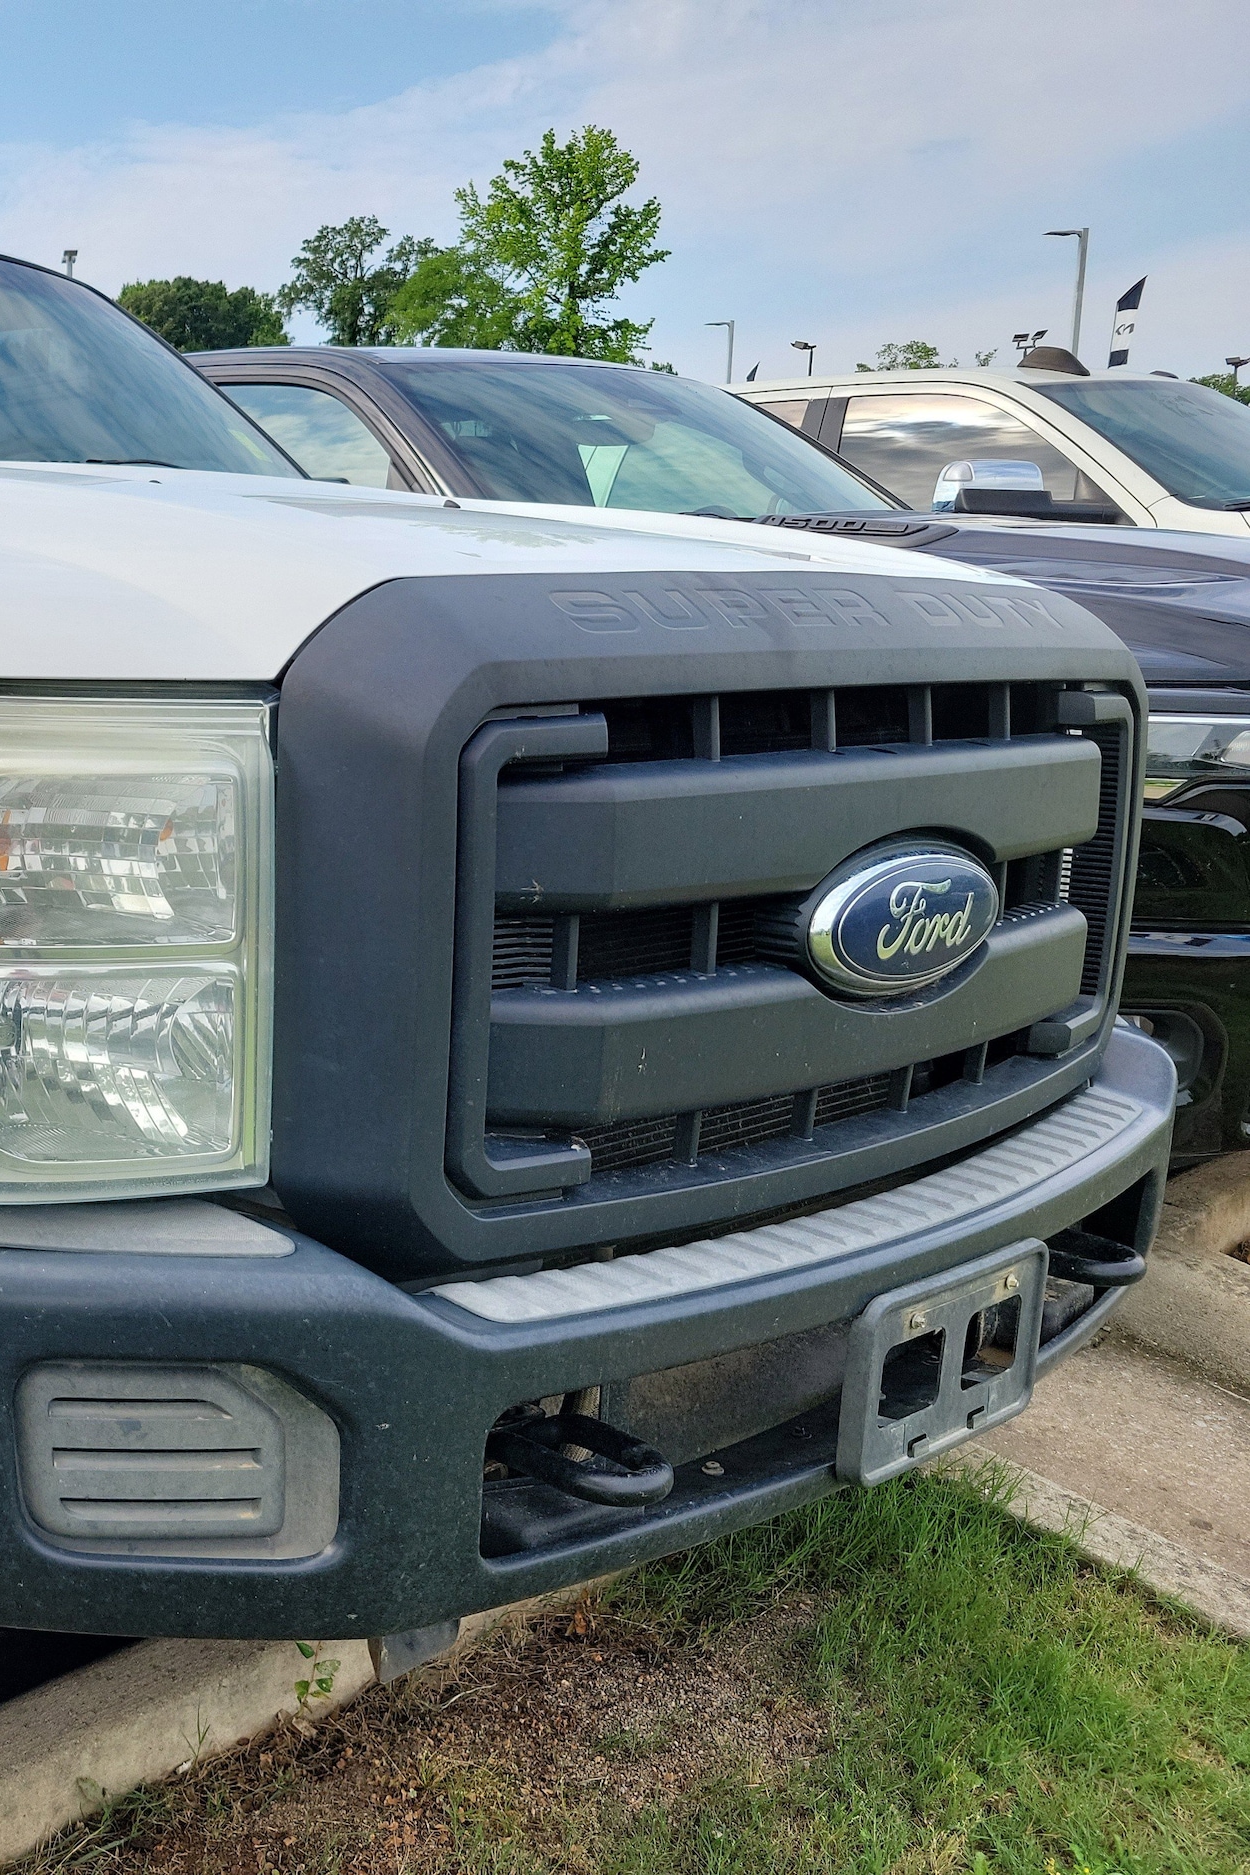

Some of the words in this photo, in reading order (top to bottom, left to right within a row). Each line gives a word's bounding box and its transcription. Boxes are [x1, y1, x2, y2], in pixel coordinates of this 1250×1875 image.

[547, 587, 892, 634] SUPER
[896, 588, 1065, 630] DUTY
[879, 879, 974, 960] Ford
